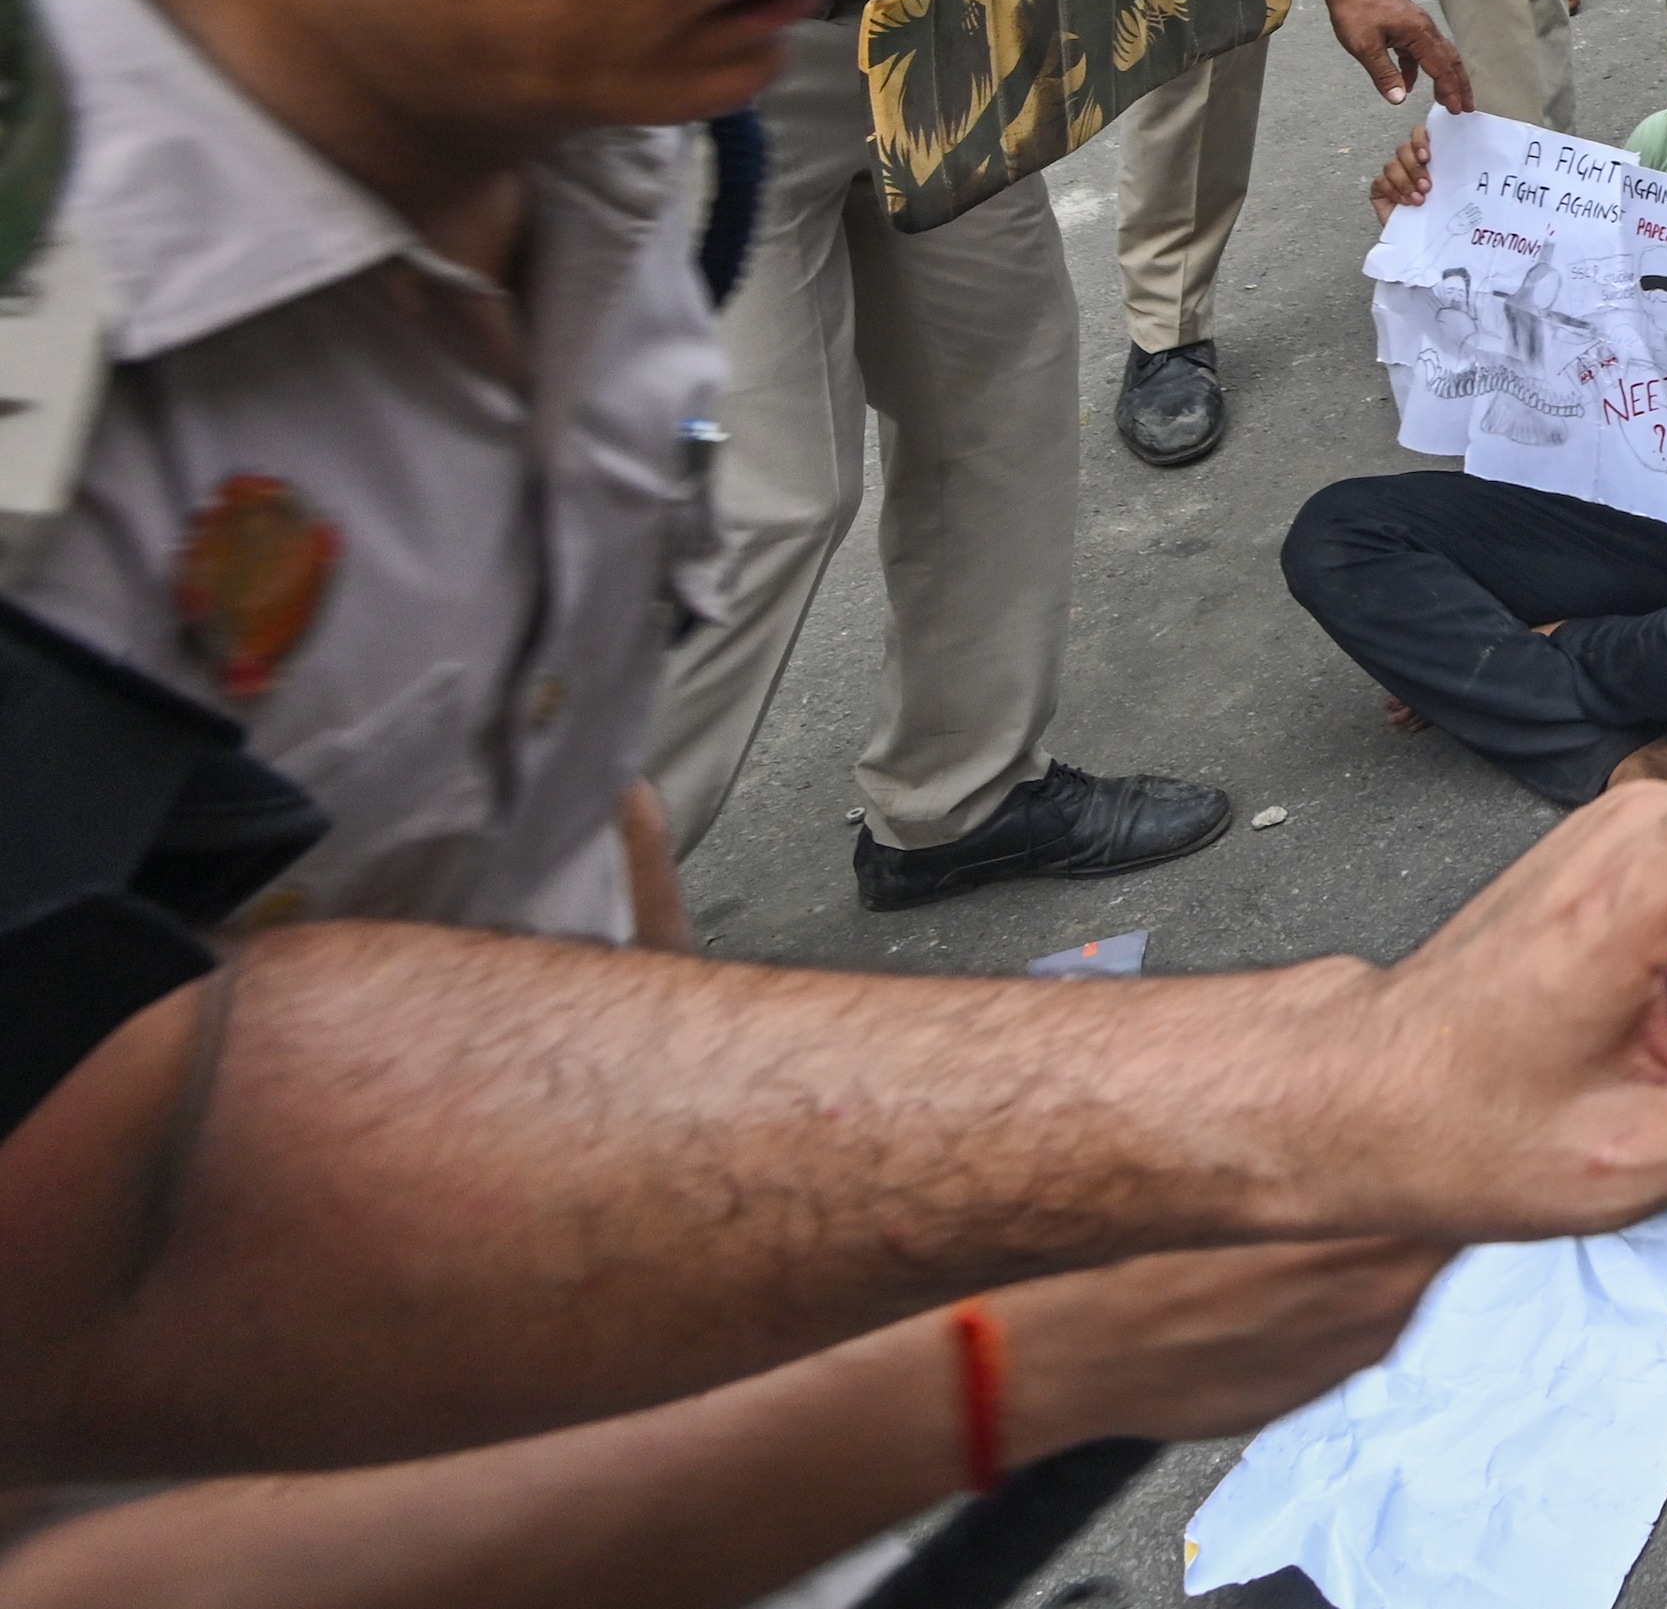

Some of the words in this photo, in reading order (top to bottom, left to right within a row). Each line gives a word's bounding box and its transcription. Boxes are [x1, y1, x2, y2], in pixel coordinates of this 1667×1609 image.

[1525, 141, 1541, 168] A
[1555, 147, 1622, 183] FIGHT
[1476, 172, 1489, 194] A
[1501, 175, 1550, 208] FIGHT
[1556, 192, 1626, 223] AGAINST
[1471, 228, 1541, 262] DETENTION?
